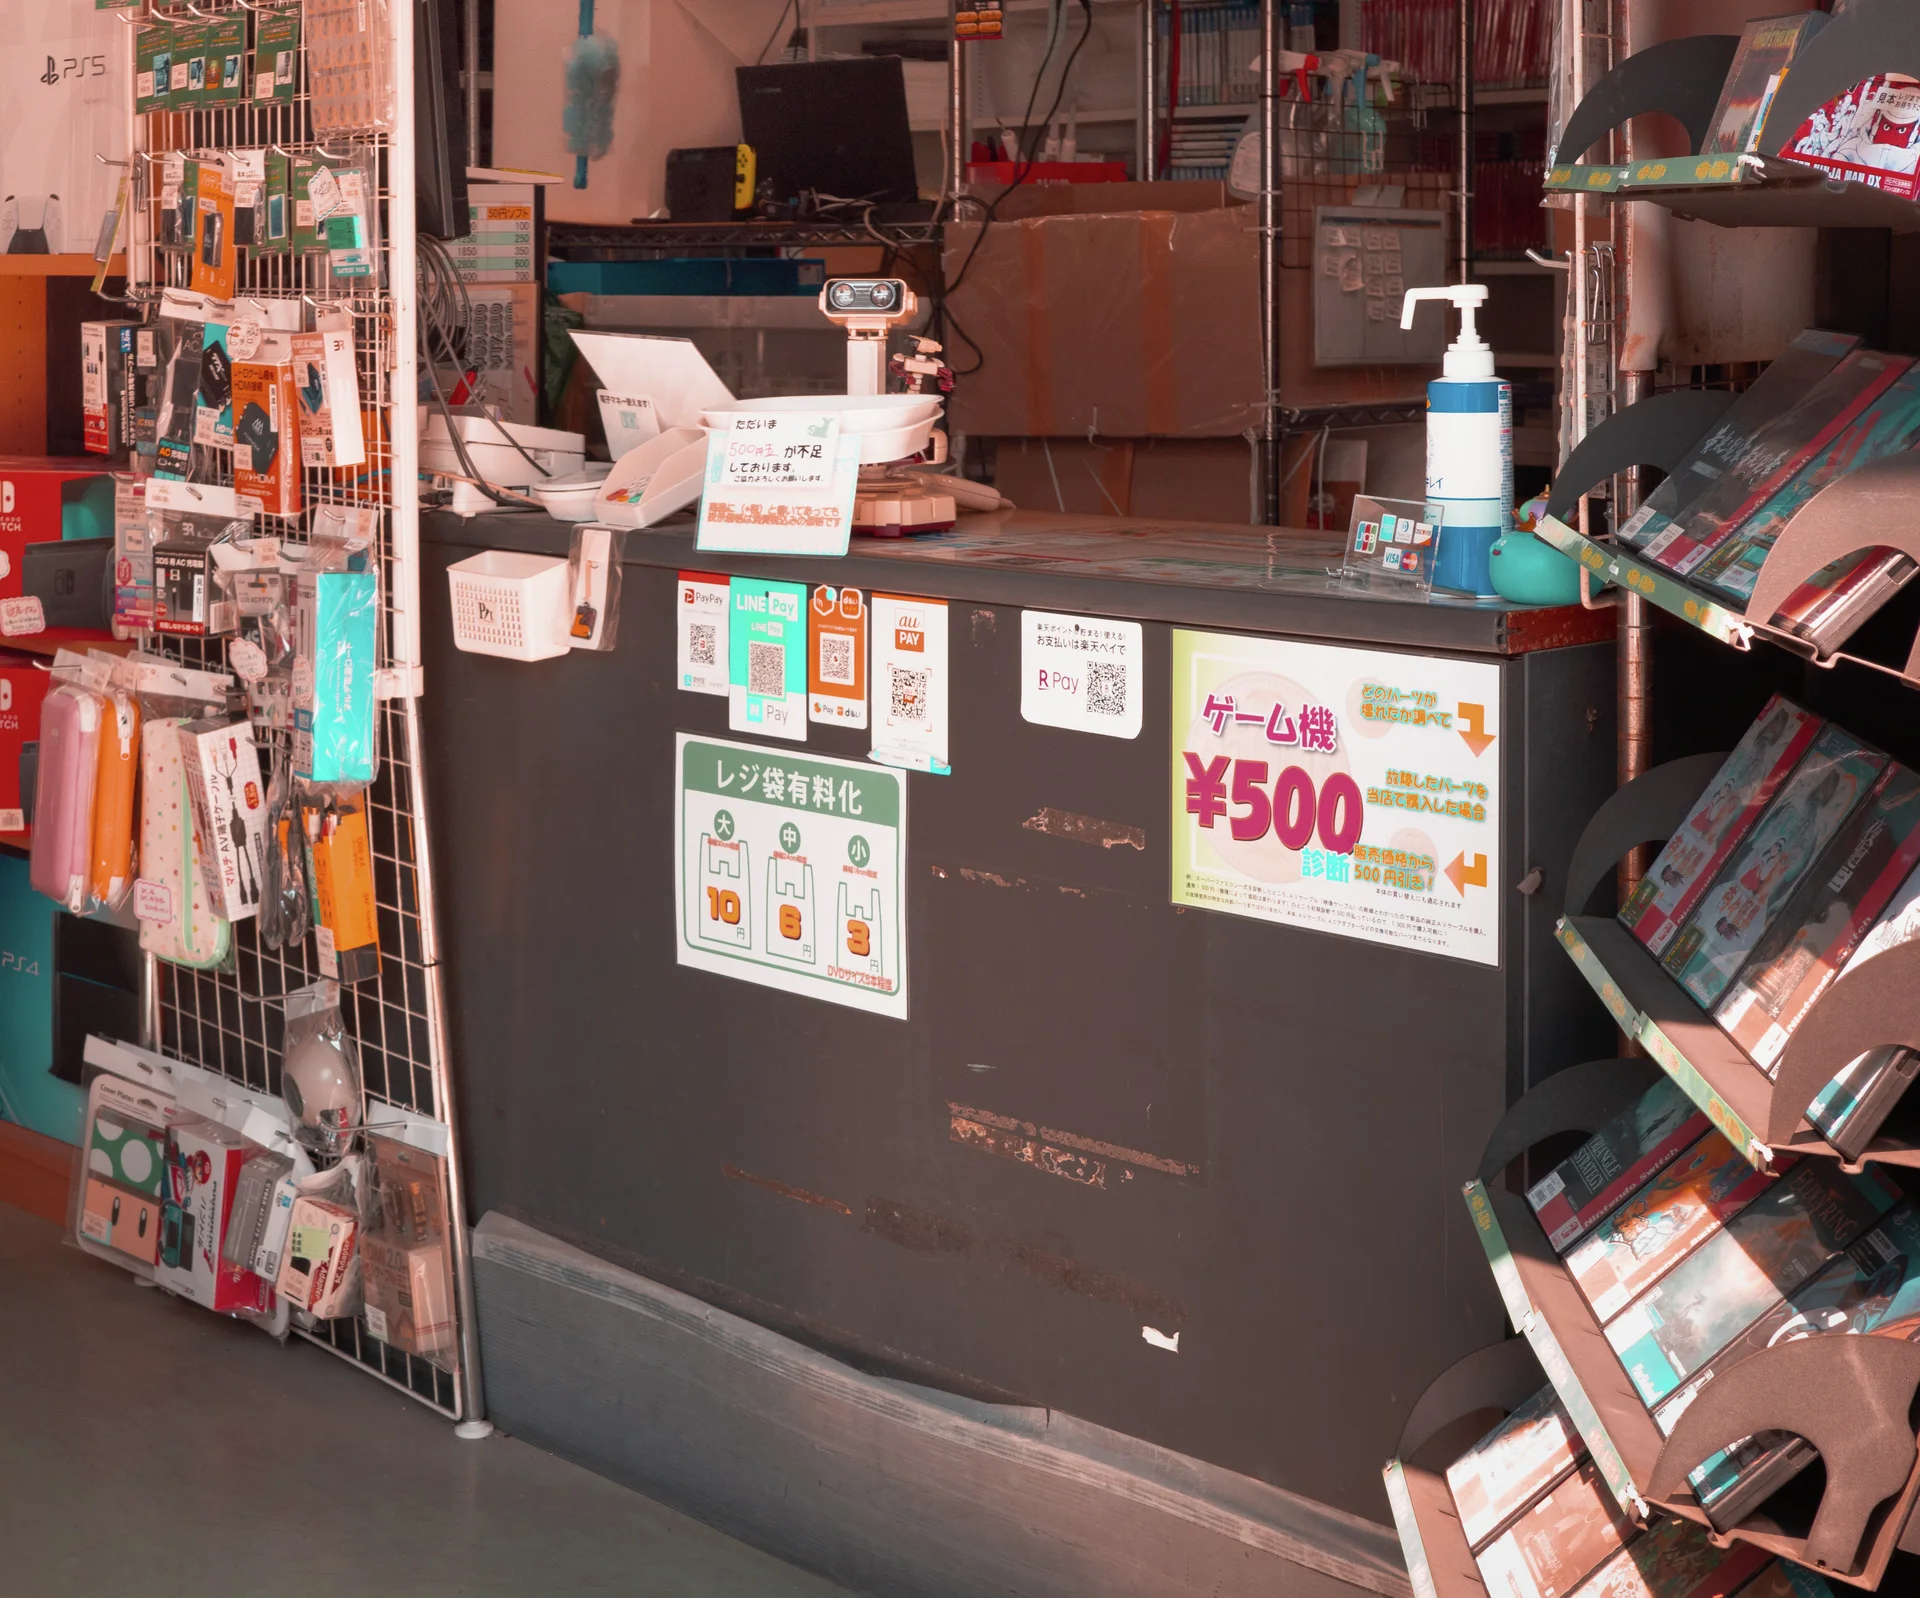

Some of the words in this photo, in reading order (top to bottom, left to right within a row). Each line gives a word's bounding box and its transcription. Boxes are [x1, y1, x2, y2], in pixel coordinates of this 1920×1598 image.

[63, 55, 106, 78] PS5
[1877, 92, 1897, 105] 見本
[488, 208, 530, 218] 50円ソフト
[515, 222, 530, 230] 100
[515, 234, 530, 243] 250
[457, 247, 477, 256] 1850
[515, 247, 530, 256] 350
[515, 272, 530, 281] 700
[736, 419, 777, 430] ただいま
[729, 442, 778, 458] 500円玉
[784, 444, 823, 459] が不足
[729, 462, 796, 473] しております。
[1357, 532, 1375, 545] JCB
[176, 558, 186, 566] AC
[1385, 553, 1400, 565] VISA
[695, 592, 723, 606] PayPay
[736, 594, 767, 613] LINE
[772, 598, 795, 617] Pay
[751, 622, 767, 633] LINE
[898, 615, 921, 629] au
[899, 631, 921, 646] PAY
[1036, 635, 1126, 656] お支払いは楽天ペイで
[1038, 669, 1051, 690] R
[1052, 671, 1080, 695] Pay
[1361, 684, 1438, 708] どのパーツが
[766, 704, 788, 726] Pay
[822, 703, 834, 715] Pay
[1360, 702, 1453, 729] 壊れたか調べて
[1202, 693, 1336, 753] ゲーム機
[716, 759, 864, 816] レジ袋有料化
[1385, 768, 1489, 800] 故障したパーツを
[1182, 751, 1364, 857] ¥500
[1366, 787, 1487, 822] 当店で購入した場合
[716, 814, 732, 836] 大
[782, 826, 798, 848] 中
[851, 840, 867, 862] 小
[1353, 843, 1435, 872] 販売価格から
[1301, 847, 1350, 884] 診断
[1376, 888, 1463, 910] 本体の買い替えにも適応されます
[706, 885, 741, 925] 10
[735, 927, 746, 941] 円
[778, 903, 801, 941] 6
[803, 944, 812, 958] 円
[847, 919, 871, 957] 3
[870, 959, 880, 973] 円
[2, 951, 40, 977] PS4
[1787, 967, 1835, 1032] Nintendo
[1834, 916, 1872, 965] Switch
[827, 965, 893, 992] DVDサイズ5本程度
[100, 1083, 117, 1097] Cover
[116, 1087, 135, 1103] Plates
[1588, 1135, 1622, 1178] TRIANGLE
[1573, 1149, 1605, 1192] STRATEGY
[1583, 1182, 1637, 1229] Nintendo
[1639, 1146, 1680, 1182] Switch
[337, 1238, 352, 1271] Adapter
[310, 1262, 329, 1300] Adapter
